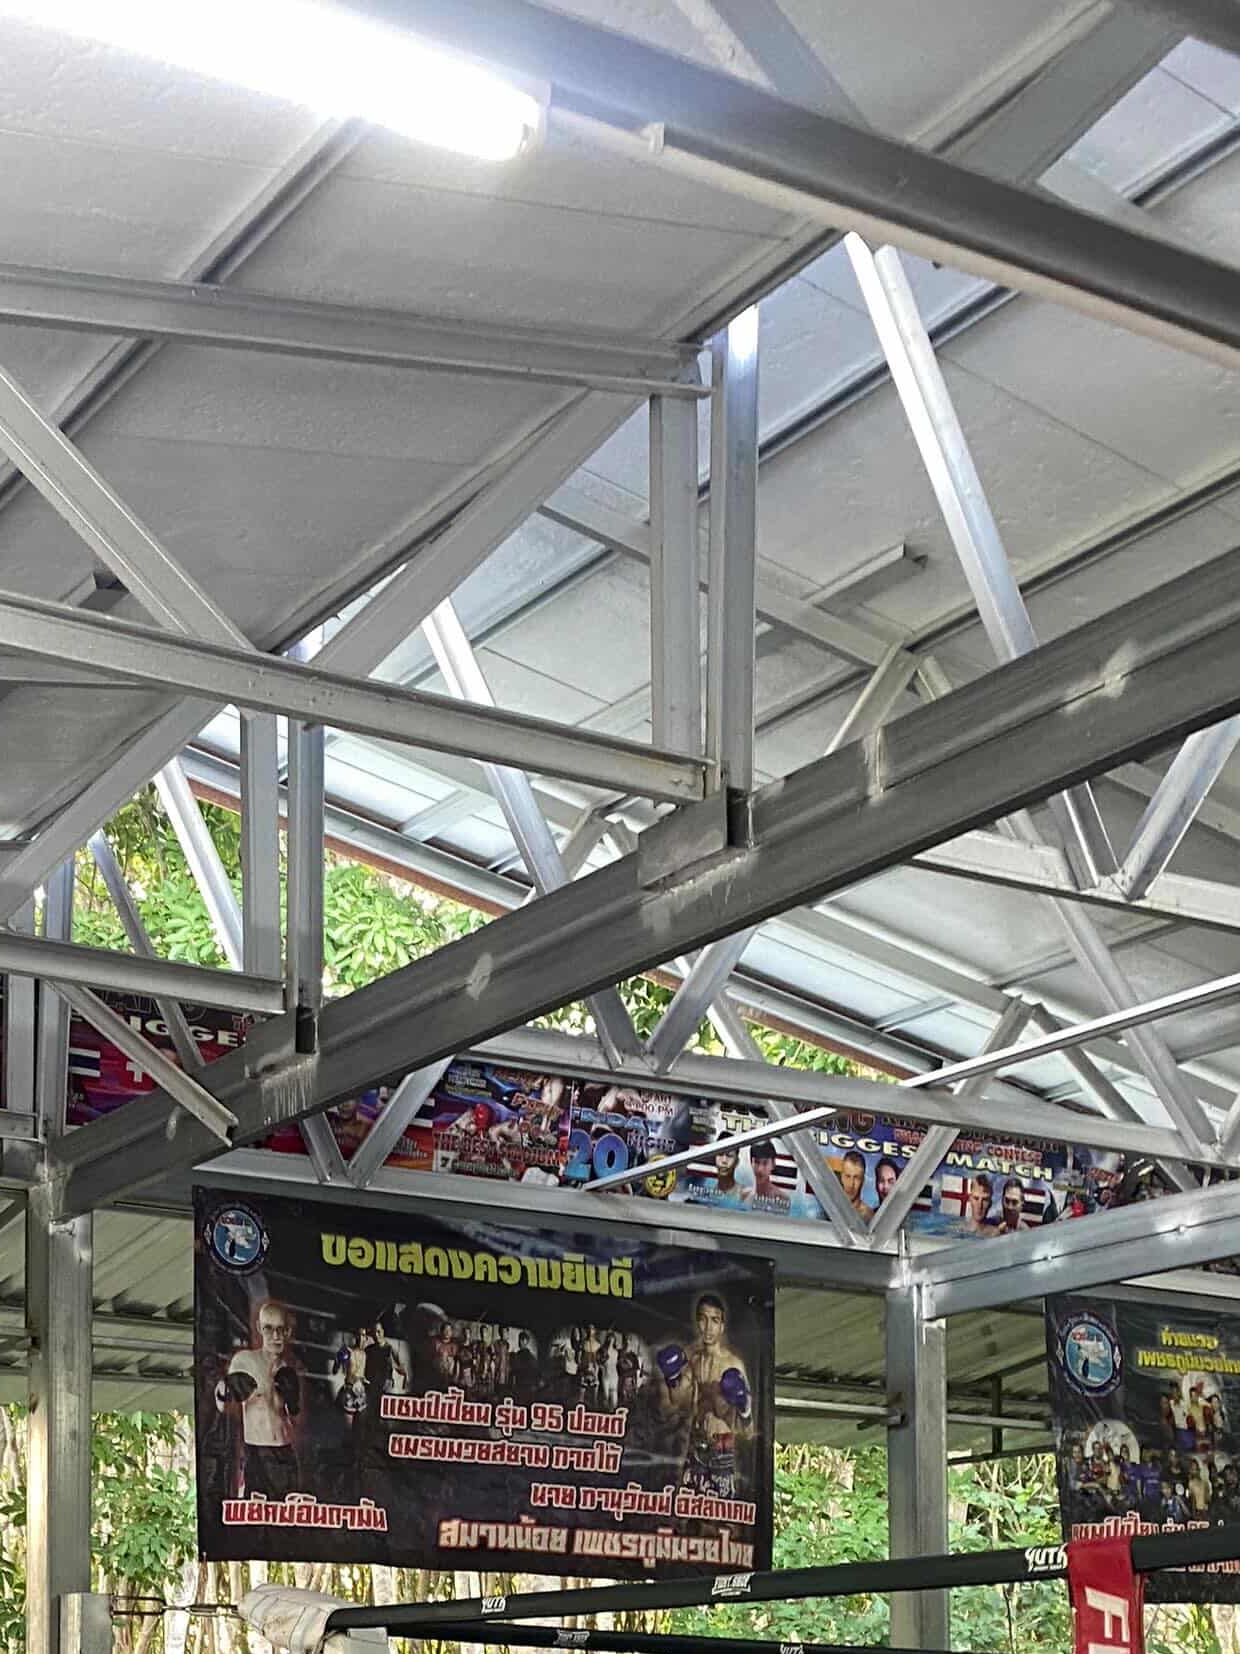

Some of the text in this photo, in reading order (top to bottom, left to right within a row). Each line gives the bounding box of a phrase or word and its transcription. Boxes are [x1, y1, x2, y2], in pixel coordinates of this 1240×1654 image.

[567, 1129, 629, 1180] 20
[946, 1152, 1053, 1180] MATCH
[321, 1233, 633, 1299] ขอแสดงความยินดี
[380, 1387, 628, 1437] แชมป์เปี้ยน รุ่น 95 ปอนด์
[389, 1434, 622, 1473] ชมรมมวยสยาม ภาคใต้
[530, 1482, 576, 1510] นาย
[439, 1515, 754, 1568] สมานน้อย เพชรภูมิมวยไทย
